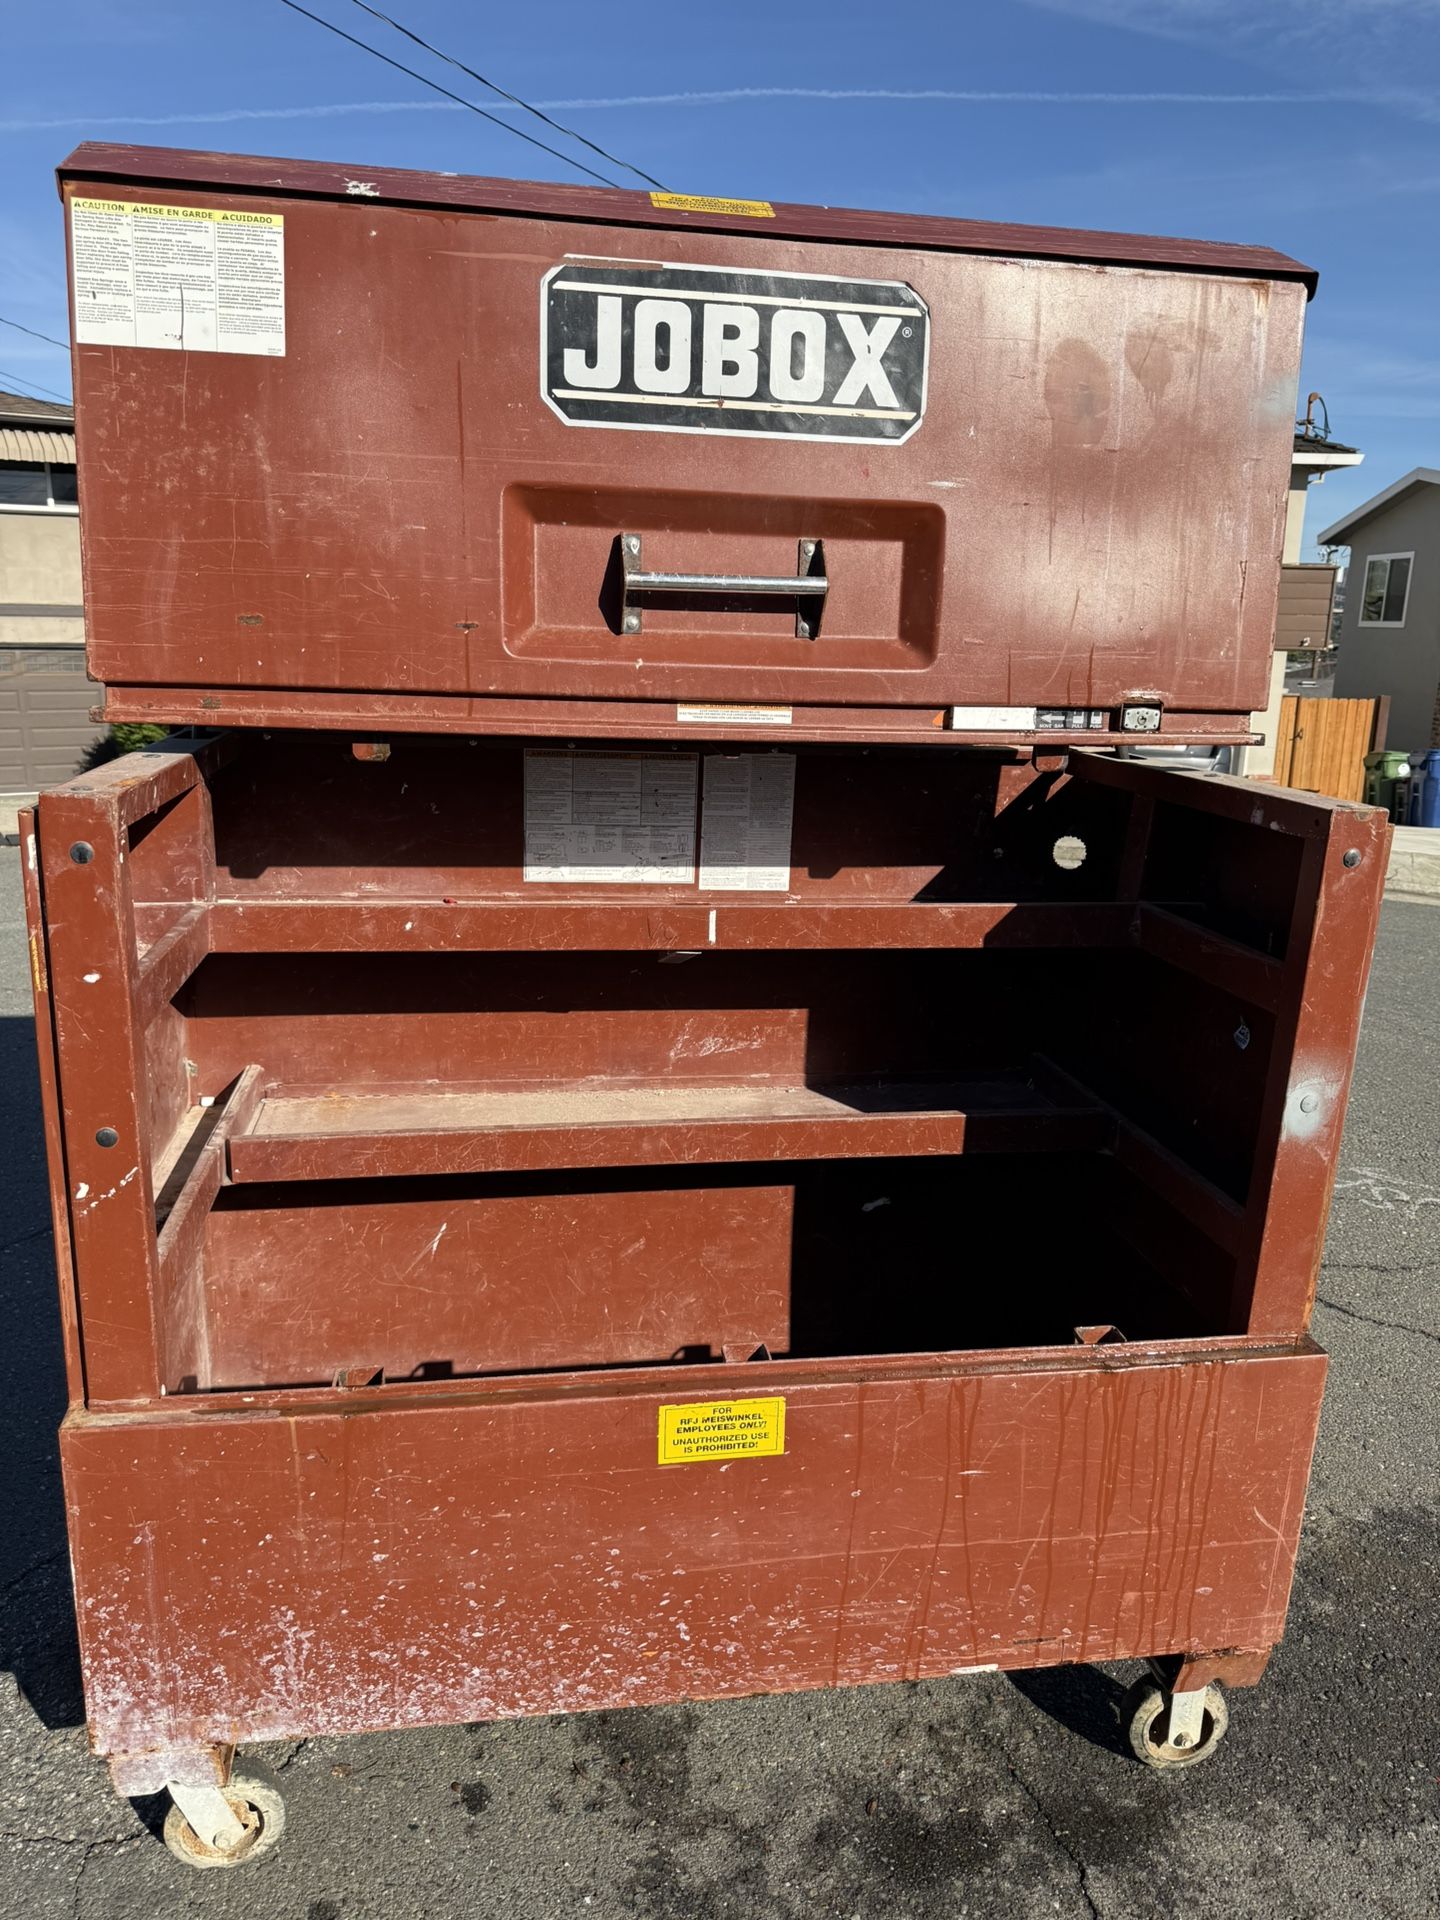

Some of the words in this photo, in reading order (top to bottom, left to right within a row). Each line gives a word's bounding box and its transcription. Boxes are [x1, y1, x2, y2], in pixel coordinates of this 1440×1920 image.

[82, 201, 125, 212] CAUTION
[140, 206, 164, 216] MISE
[167, 208, 179, 216] EN
[182, 210, 213, 219] GARDE
[230, 213, 273, 224] CUIDADO
[563, 295, 903, 408] JOBOX
[712, 1407, 732, 1415] FOR
[680, 1418, 699, 1426] RFJ
[702, 1413, 763, 1423] MEISWINKEL
[676, 1423, 737, 1434] EMPLOYEES
[739, 1421, 768, 1430] ONLY!
[672, 1434, 748, 1446] UNAUTHORIZED
[751, 1432, 769, 1440] USE
[684, 1446, 693, 1454] IS
[696, 1442, 759, 1453] PROHIBITED!
